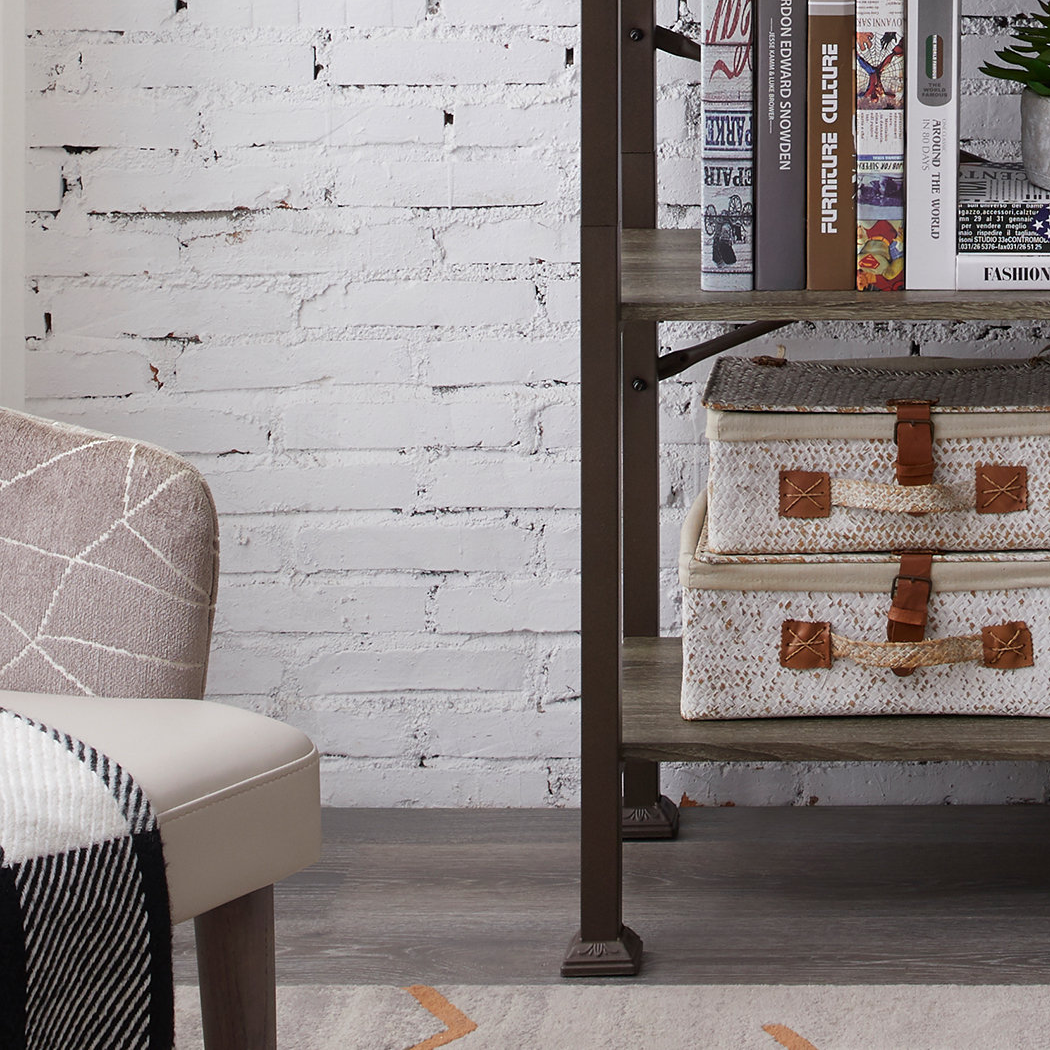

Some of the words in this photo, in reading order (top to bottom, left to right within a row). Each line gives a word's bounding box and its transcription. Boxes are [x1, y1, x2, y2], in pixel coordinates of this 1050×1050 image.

[780, 40, 792, 98] EDWARD
[822, 44, 838, 124] CULTURE
[779, 102, 792, 170] SNOWDEN
[922, 119, 930, 131] IN
[922, 134, 930, 144] 80
[932, 119, 942, 167] AROUND
[922, 146, 930, 171] DAYS
[821, 132, 838, 234] FURNITURE
[931, 172, 940, 193] THE
[930, 199, 940, 239] WORLD
[984, 267, 1050, 282] FASHION
